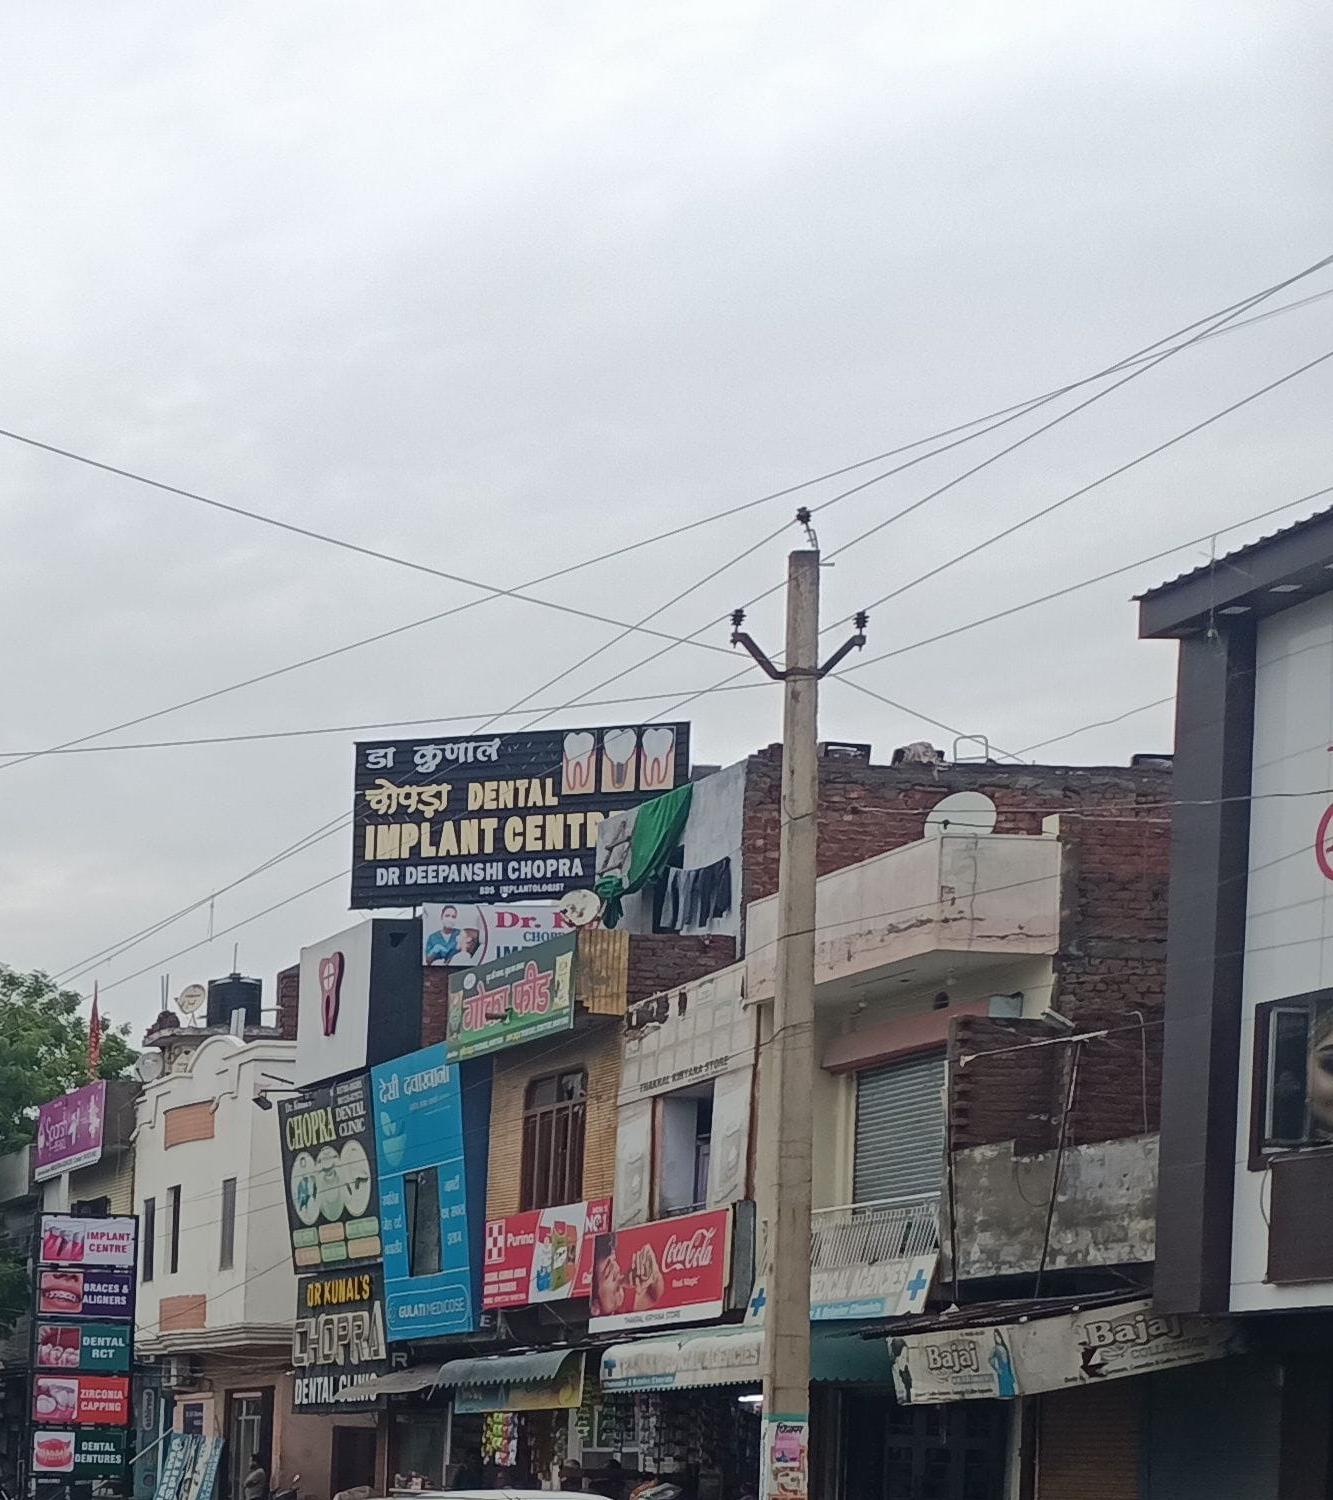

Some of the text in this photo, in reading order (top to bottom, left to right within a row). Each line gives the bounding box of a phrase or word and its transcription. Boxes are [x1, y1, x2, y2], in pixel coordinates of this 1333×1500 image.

[413, 738, 502, 773] कुणाल
[365, 778, 452, 818] चोपड़ा
[467, 778, 559, 811] DENTAL
[364, 817, 498, 861] IMPLANT
[375, 858, 583, 887] DR DEEPANSHI CHOPRA
[495, 911, 541, 928] Dr.
[704, 1055, 730, 1073] STORE
[379, 1071, 400, 1103] देसी
[404, 1064, 450, 1096] दवाखाना
[286, 1101, 367, 1151] CHOPRA DENTAL
[338, 1118, 366, 1138] CLINIC
[86, 1231, 131, 1242] IMPLANT
[506, 1230, 535, 1248] Purina
[88, 1243, 128, 1254] CENTRE
[83, 1282, 129, 1294] BRACES &
[307, 1273, 371, 1308] DR KUNAL'S
[82, 1294, 127, 1306] ALIGNERS
[398, 1297, 465, 1319] GULATI MEDICOSE
[665, 1310, 681, 1319] STORE
[291, 1299, 387, 1368] CHOPRA
[1084, 1313, 1182, 1349] Bajaj
[82, 1336, 126, 1347] DENTAL
[91, 1349, 115, 1359] RCT
[925, 1340, 980, 1373] Bajaj
[80, 1389, 124, 1400] ZIRCONIA
[294, 1374, 336, 1405] DENTAL
[80, 1402, 122, 1412] CAPPING
[81, 1441, 116, 1452] DENTAL
[74, 1454, 122, 1464] DENTURES
